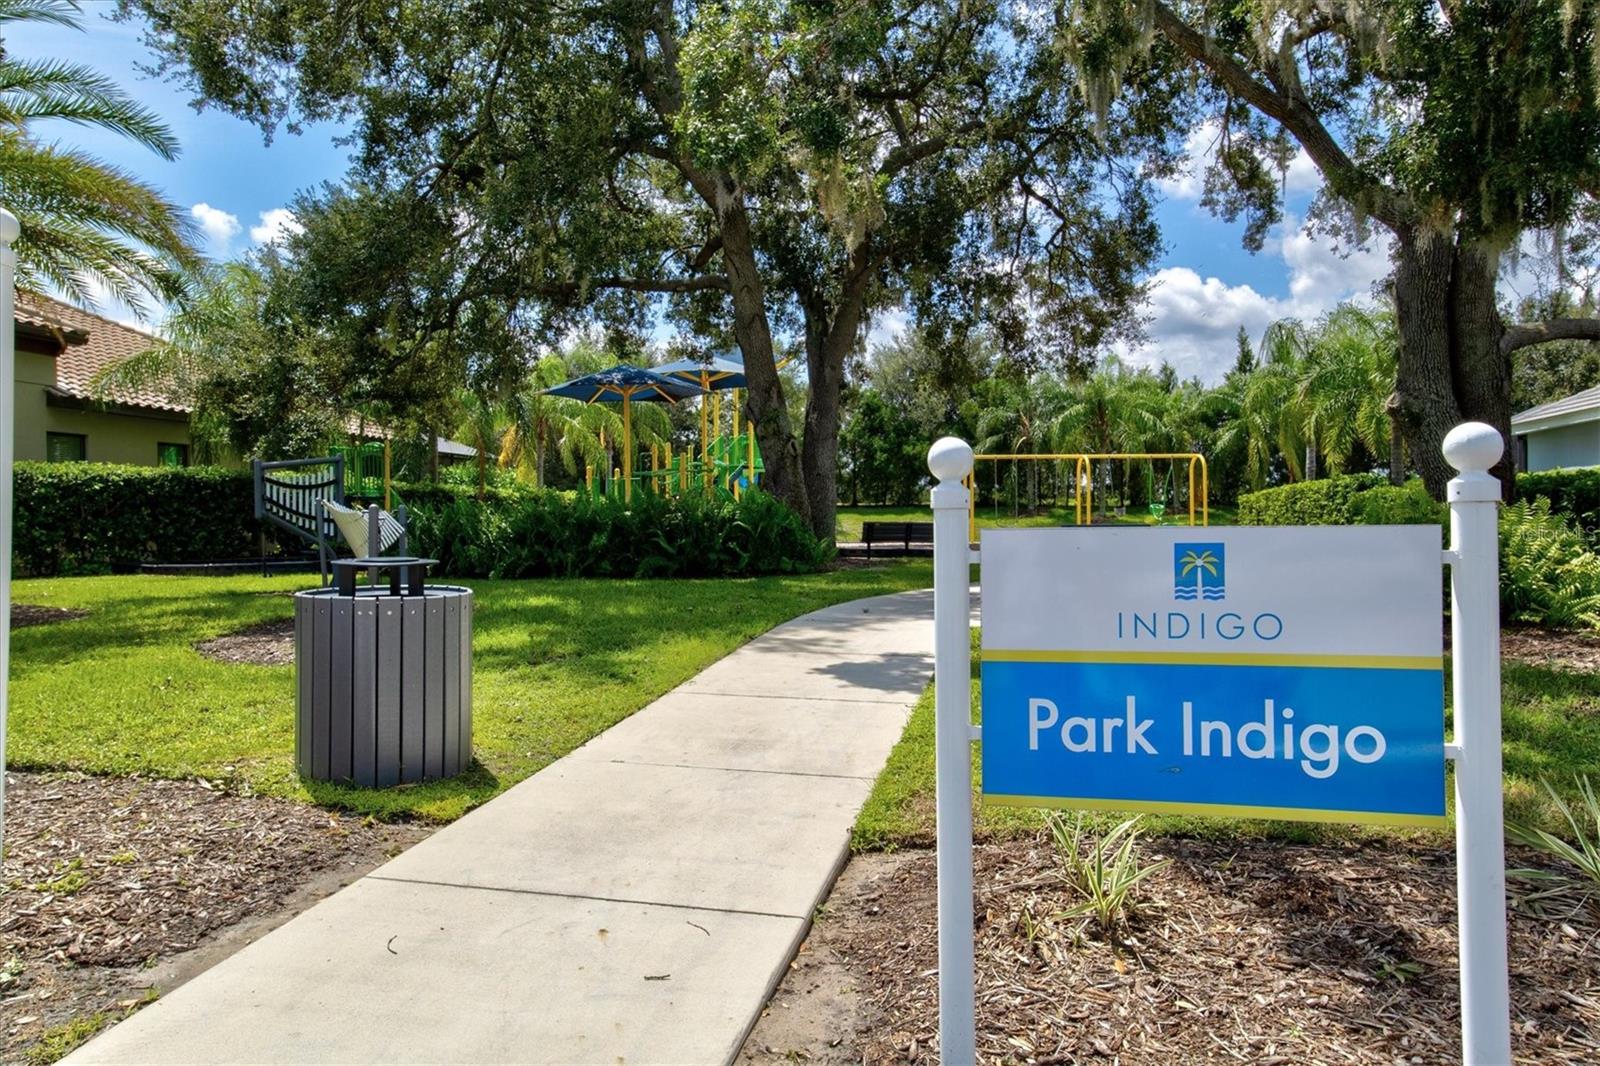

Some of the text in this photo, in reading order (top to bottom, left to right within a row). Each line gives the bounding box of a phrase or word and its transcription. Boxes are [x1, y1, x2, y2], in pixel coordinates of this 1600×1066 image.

[1118, 612, 1284, 640] INDIGO
[1028, 696, 1386, 779] Park Indigo
